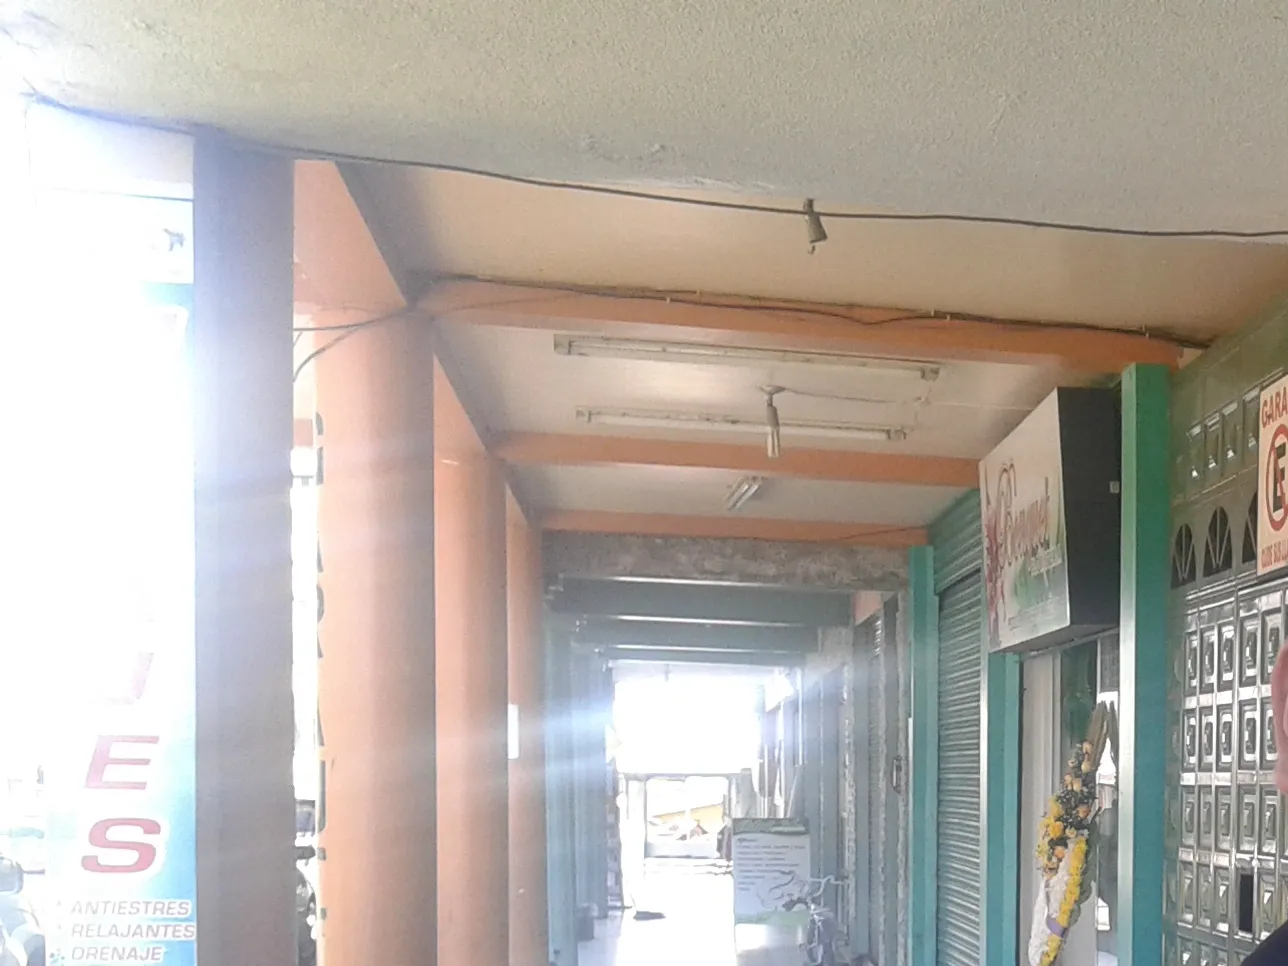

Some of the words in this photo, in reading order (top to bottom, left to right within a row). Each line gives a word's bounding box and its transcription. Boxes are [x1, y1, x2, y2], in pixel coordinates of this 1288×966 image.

[71, 900, 190, 916] ANTIESTRES
[71, 923, 196, 938] RELAJANTES
[71, 946, 163, 961] DRENAJE
